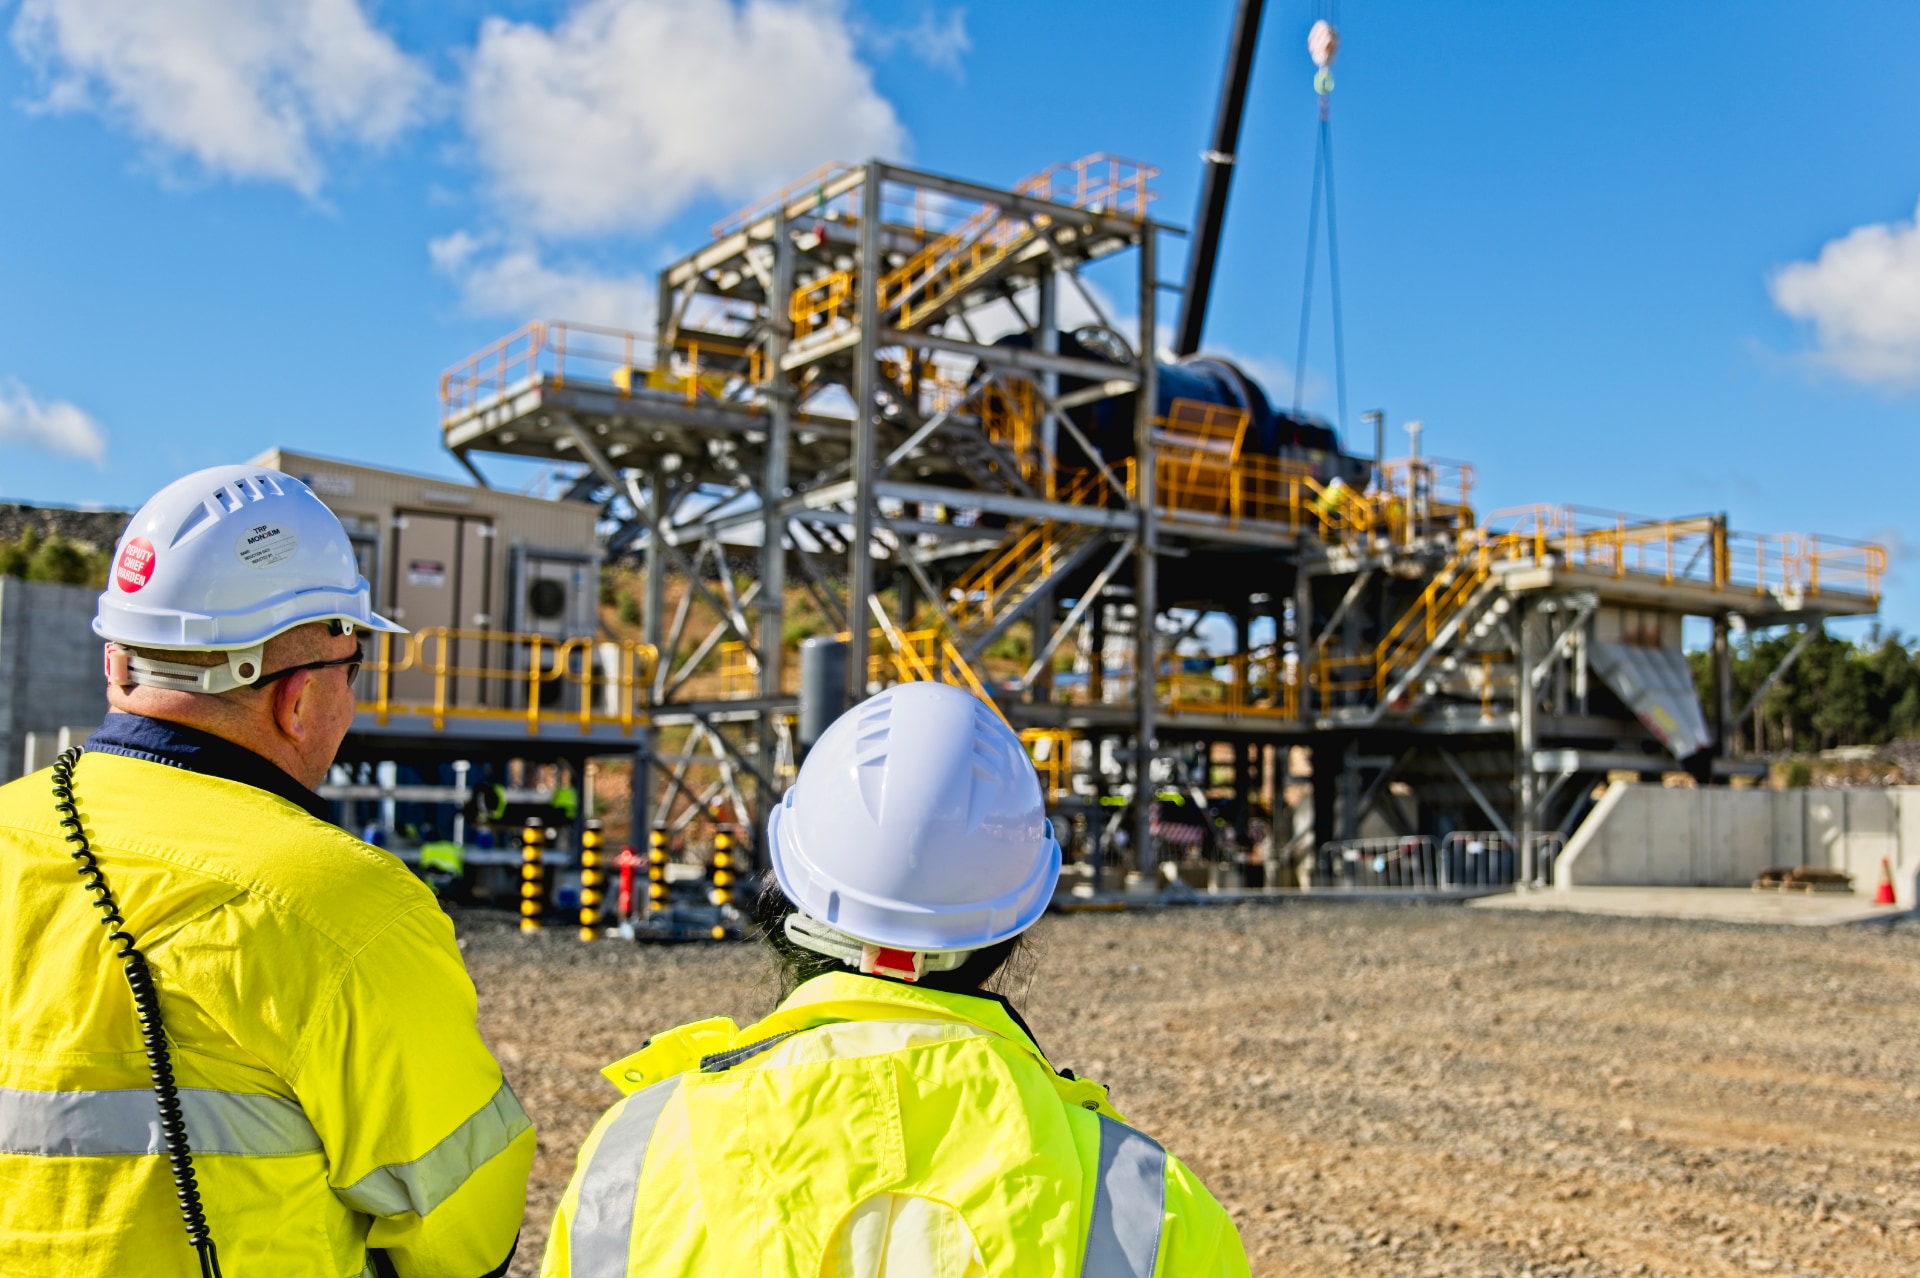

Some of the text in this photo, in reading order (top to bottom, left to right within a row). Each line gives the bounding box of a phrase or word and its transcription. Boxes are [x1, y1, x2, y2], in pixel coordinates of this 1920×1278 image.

[247, 528, 280, 544] MONDIUM
[253, 525, 267, 534] TRP
[125, 544, 153, 562] DEPUTY
[124, 556, 144, 571] CHIEF
[118, 566, 146, 586] WARDEN
